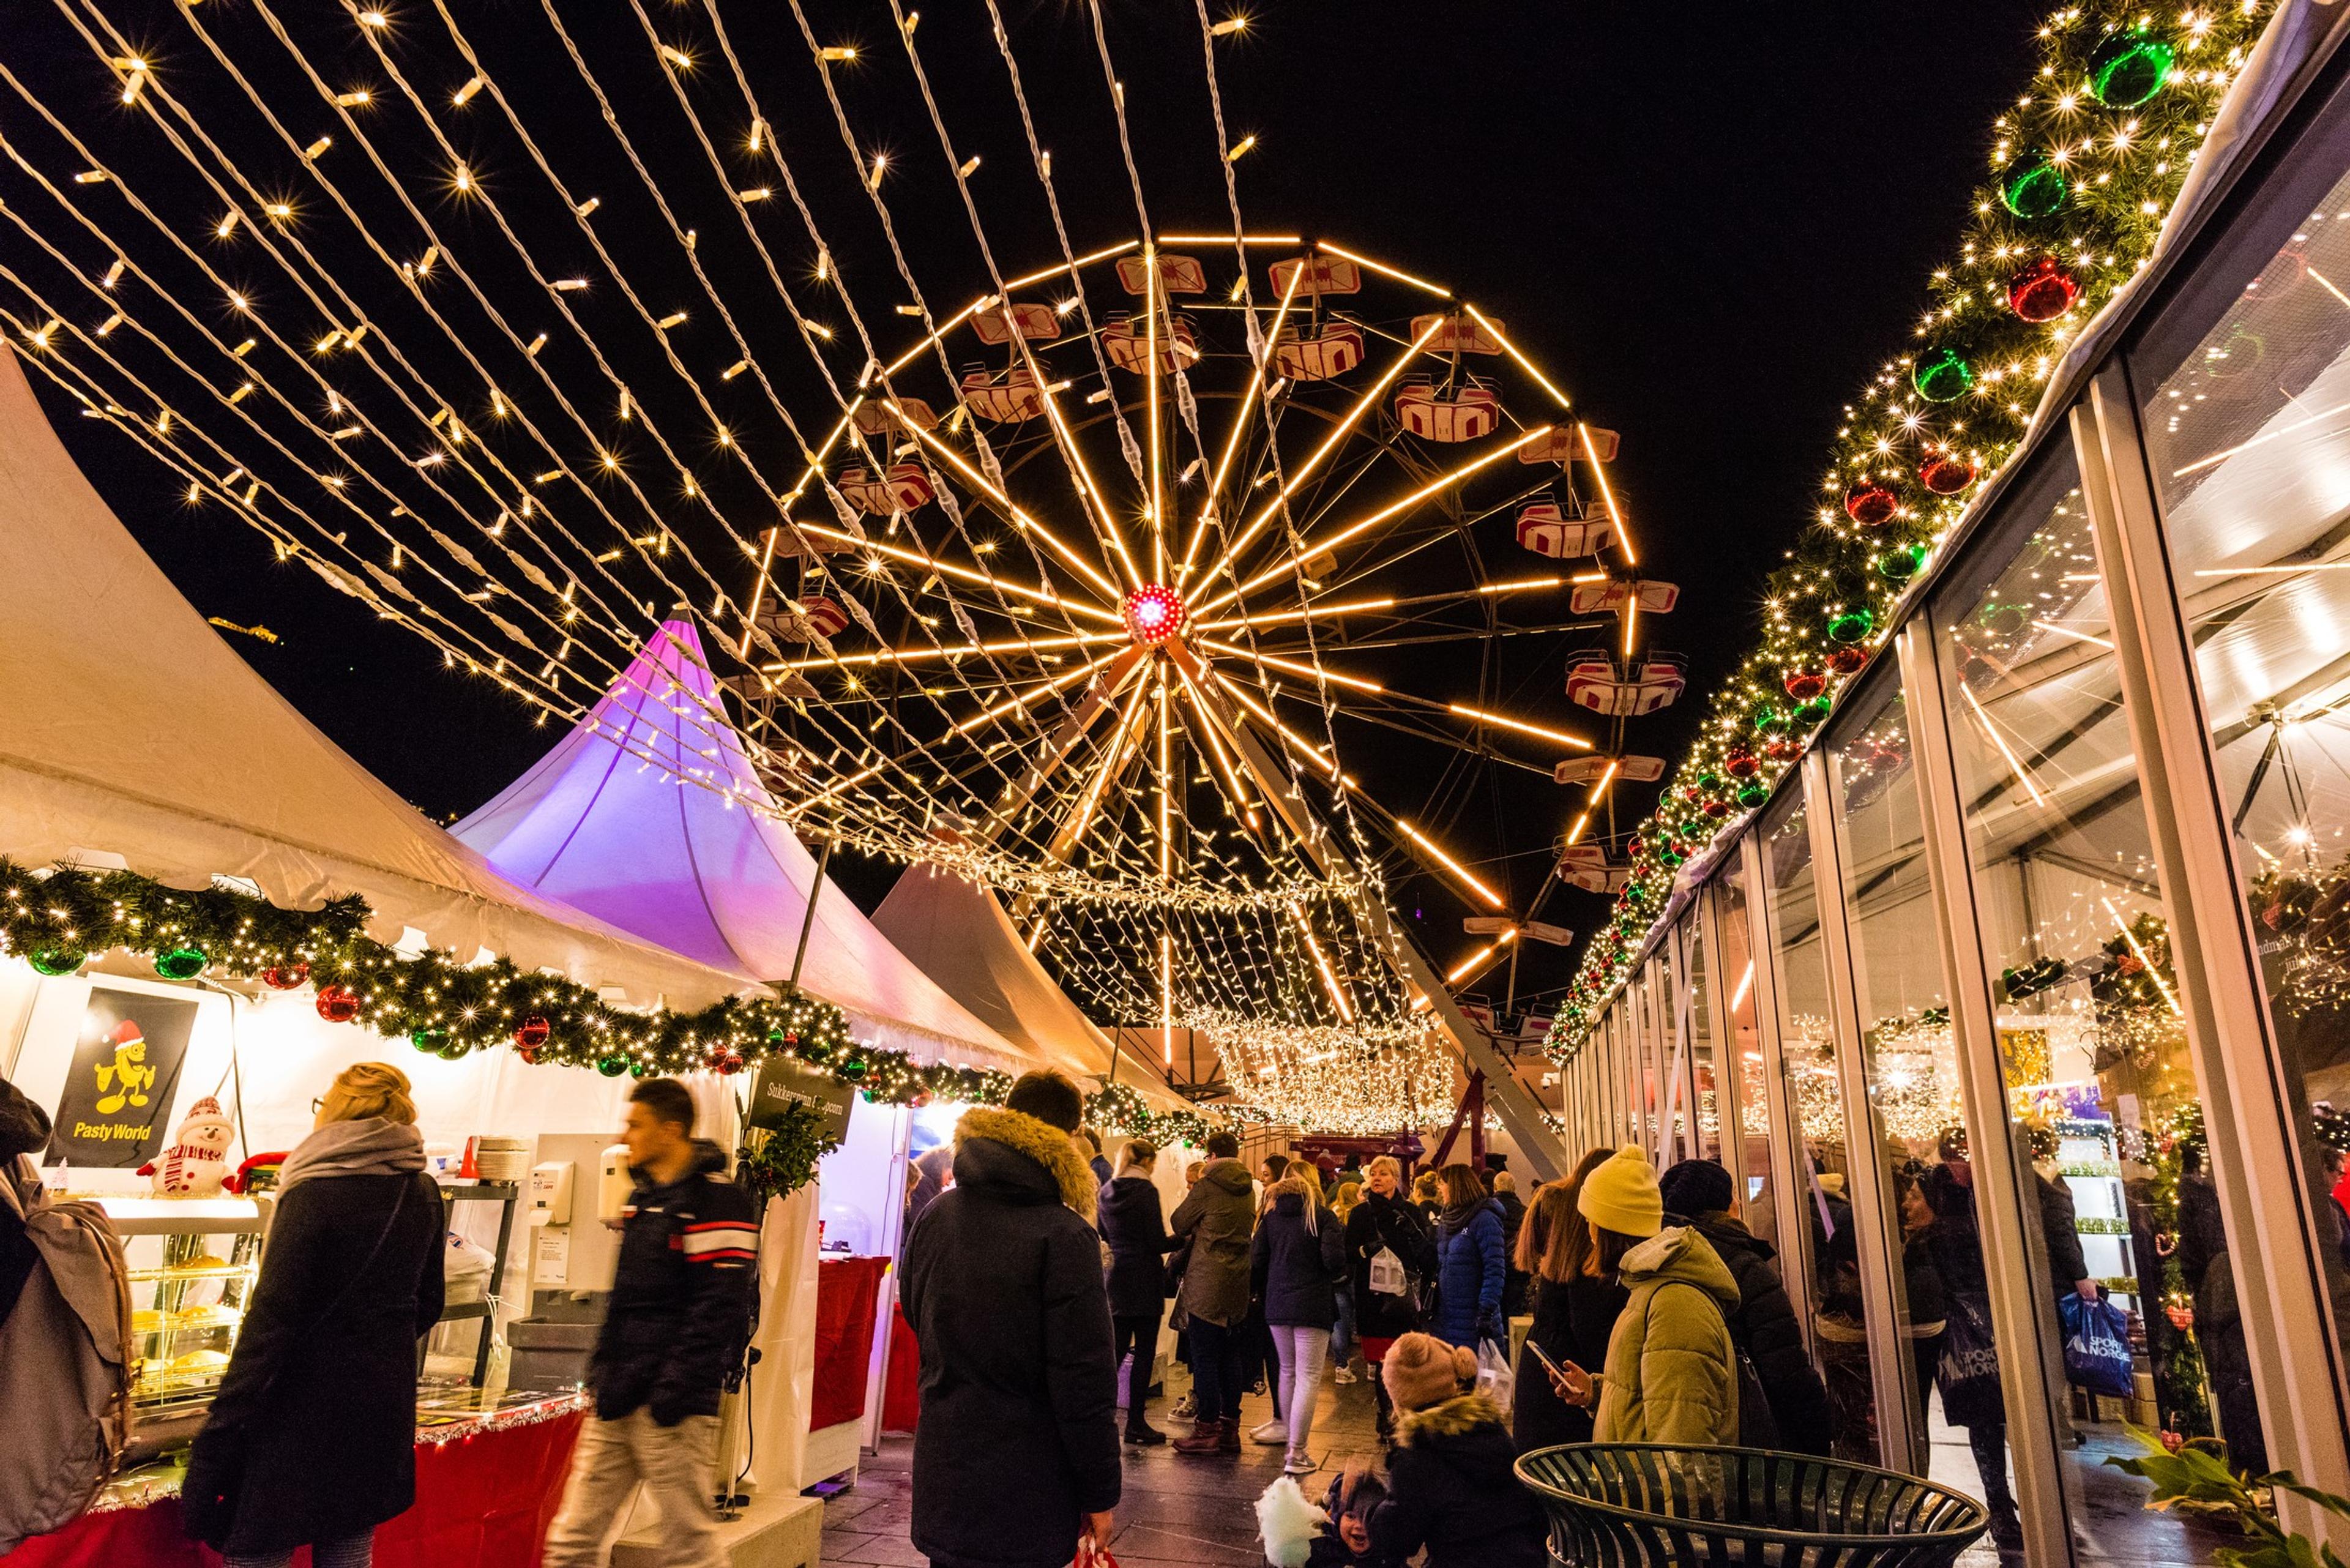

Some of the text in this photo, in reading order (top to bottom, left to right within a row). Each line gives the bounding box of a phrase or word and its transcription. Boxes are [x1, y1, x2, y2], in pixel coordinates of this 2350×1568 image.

[73, 1121, 152, 1141] Pasty World
[2089, 1335, 2123, 1350] SPORT
[2089, 1345, 2131, 1362] NORGE
